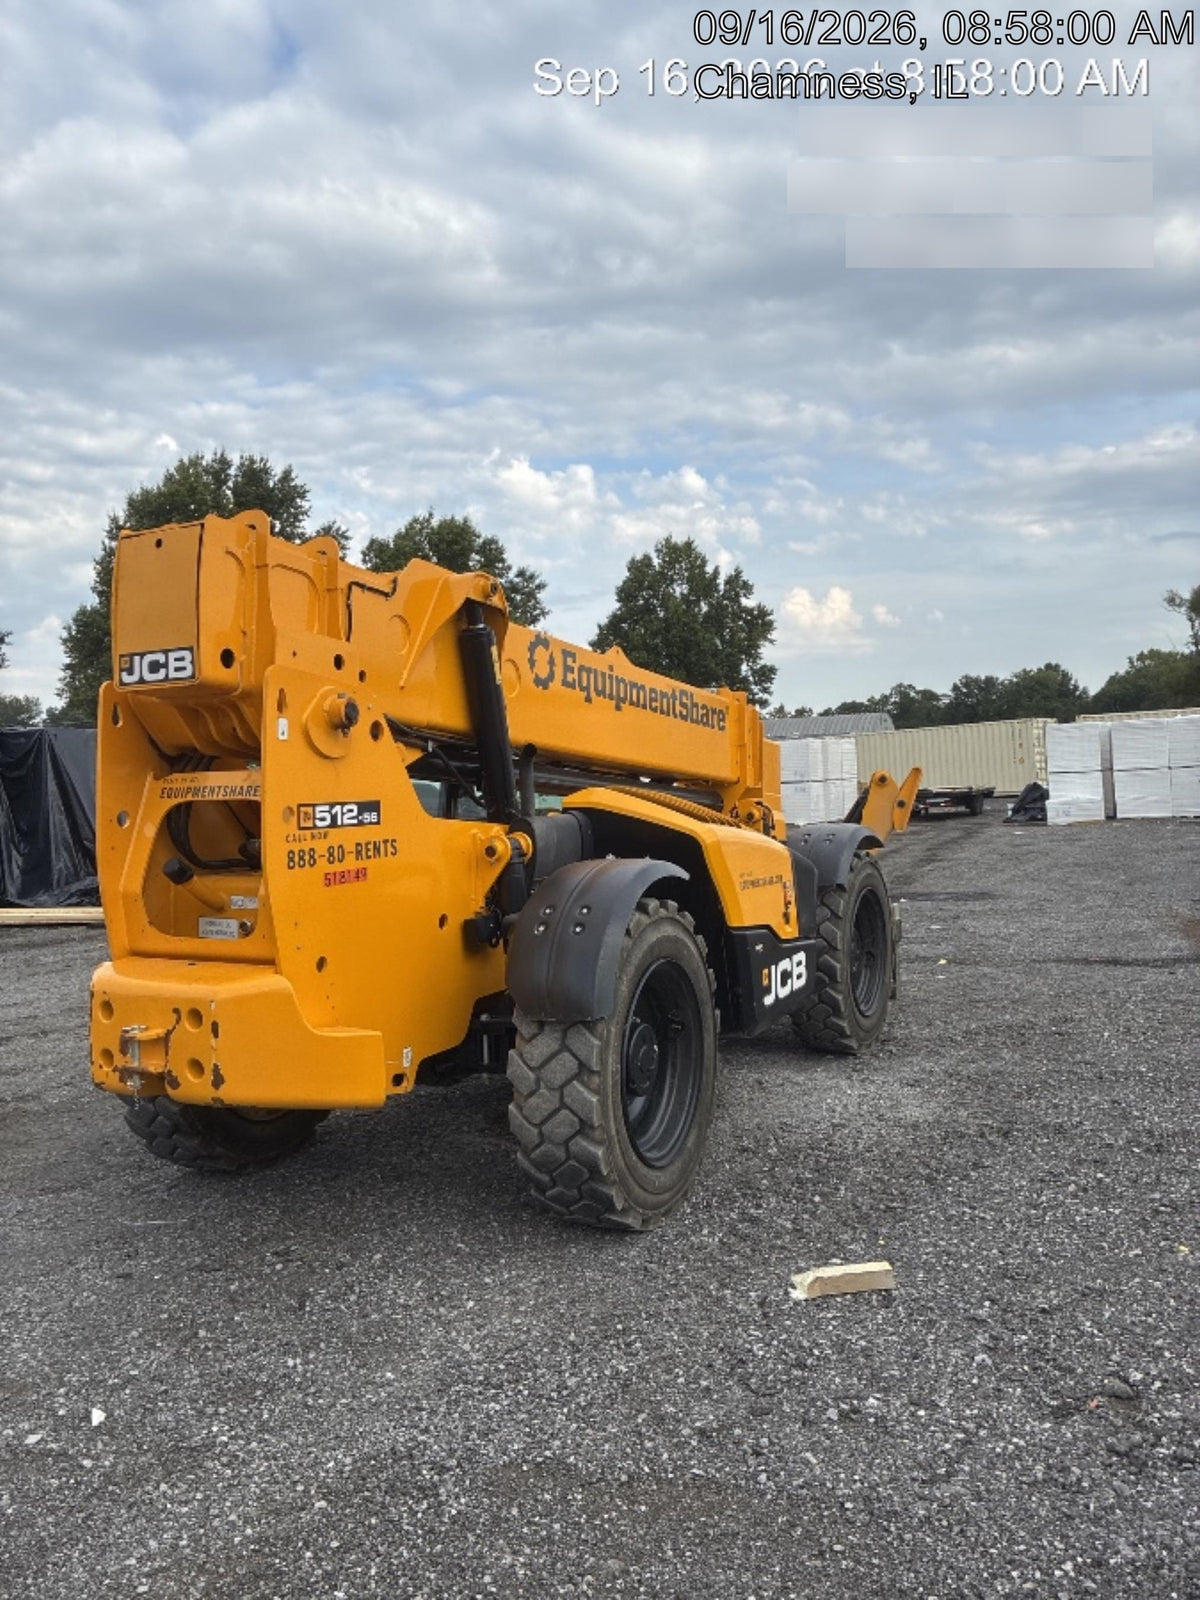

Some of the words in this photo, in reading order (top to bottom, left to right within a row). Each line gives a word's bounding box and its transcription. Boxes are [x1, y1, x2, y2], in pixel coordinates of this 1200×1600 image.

[120, 649, 194, 684] JCB
[561, 648, 727, 732] EquipmentShare
[287, 838, 398, 870] 888-80-RENTS
[763, 950, 807, 1006] JCB
